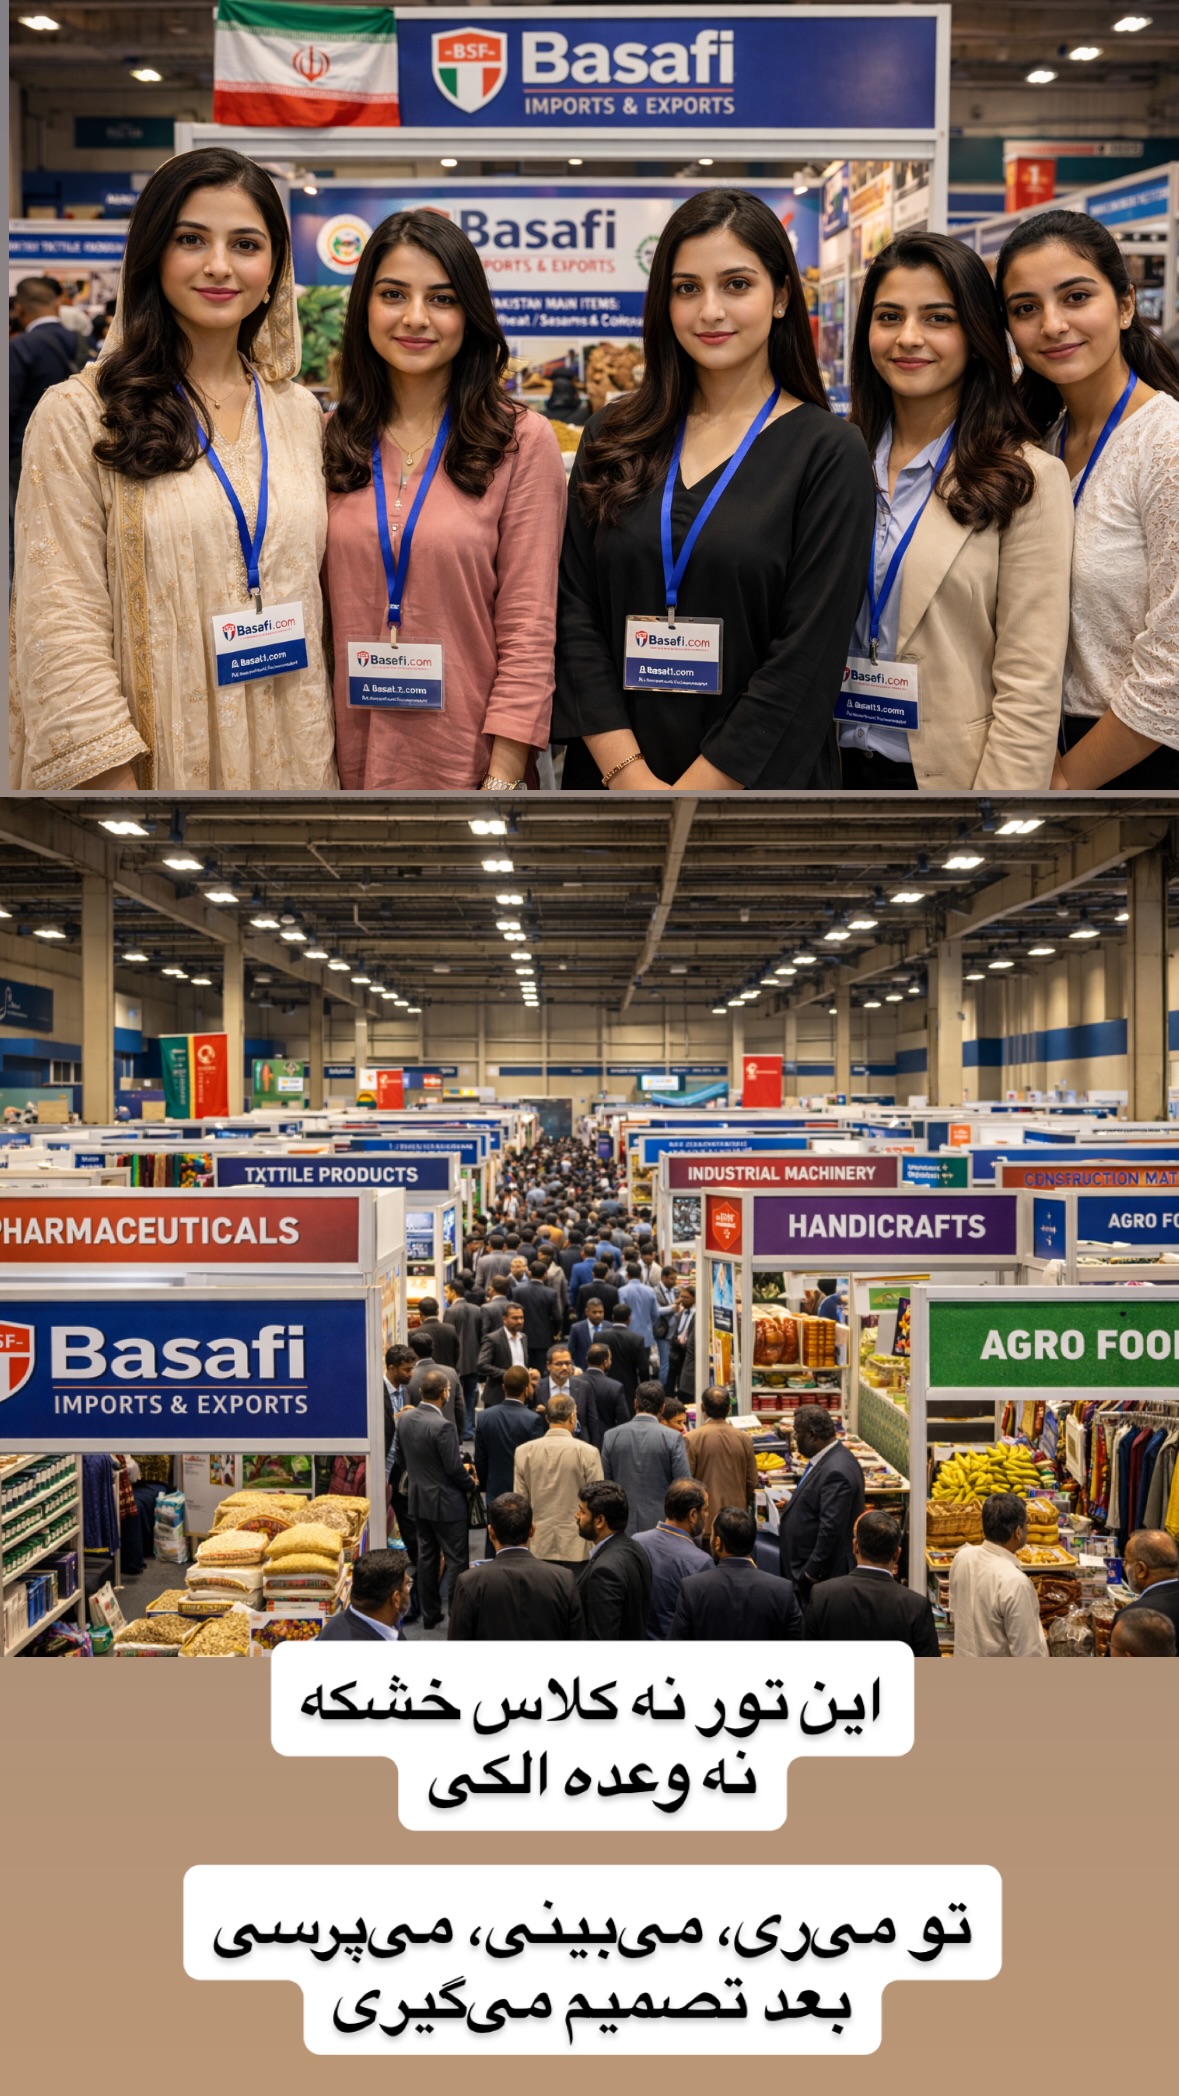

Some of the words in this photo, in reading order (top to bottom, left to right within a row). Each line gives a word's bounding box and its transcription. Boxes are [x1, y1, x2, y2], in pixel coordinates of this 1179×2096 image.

[522, 29, 734, 84] Basafi
[525, 96, 615, 114] IMPORTS
[622, 96, 638, 114] &
[646, 96, 736, 114] EXPORTS
[459, 208, 616, 250] Basafi
[482, 258, 532, 273] PORTS
[537, 259, 547, 272] &
[493, 297, 542, 311] AKISTAN
[545, 297, 578, 311] MAIN
[237, 618, 296, 637] Basafi.com
[245, 1167, 314, 1183] TXTTILE
[319, 1167, 419, 1183] PRODUCTS
[688, 1166, 780, 1181] INDUSTRIAL
[784, 1166, 876, 1181] MACHINERY
[788, 1213, 986, 1238] HANDICRAFTS
[1107, 1213, 1157, 1228] AGRO
[0, 1216, 300, 1245] HARMACEUTICALS
[51, 1324, 305, 1379] Basafi
[980, 1329, 1085, 1360] AGRO
[1097, 1329, 1179, 1360] FOO
[54, 1395, 163, 1414] IMPORTS
[170, 1395, 188, 1414] &
[198, 1395, 308, 1414] EXPORTS
